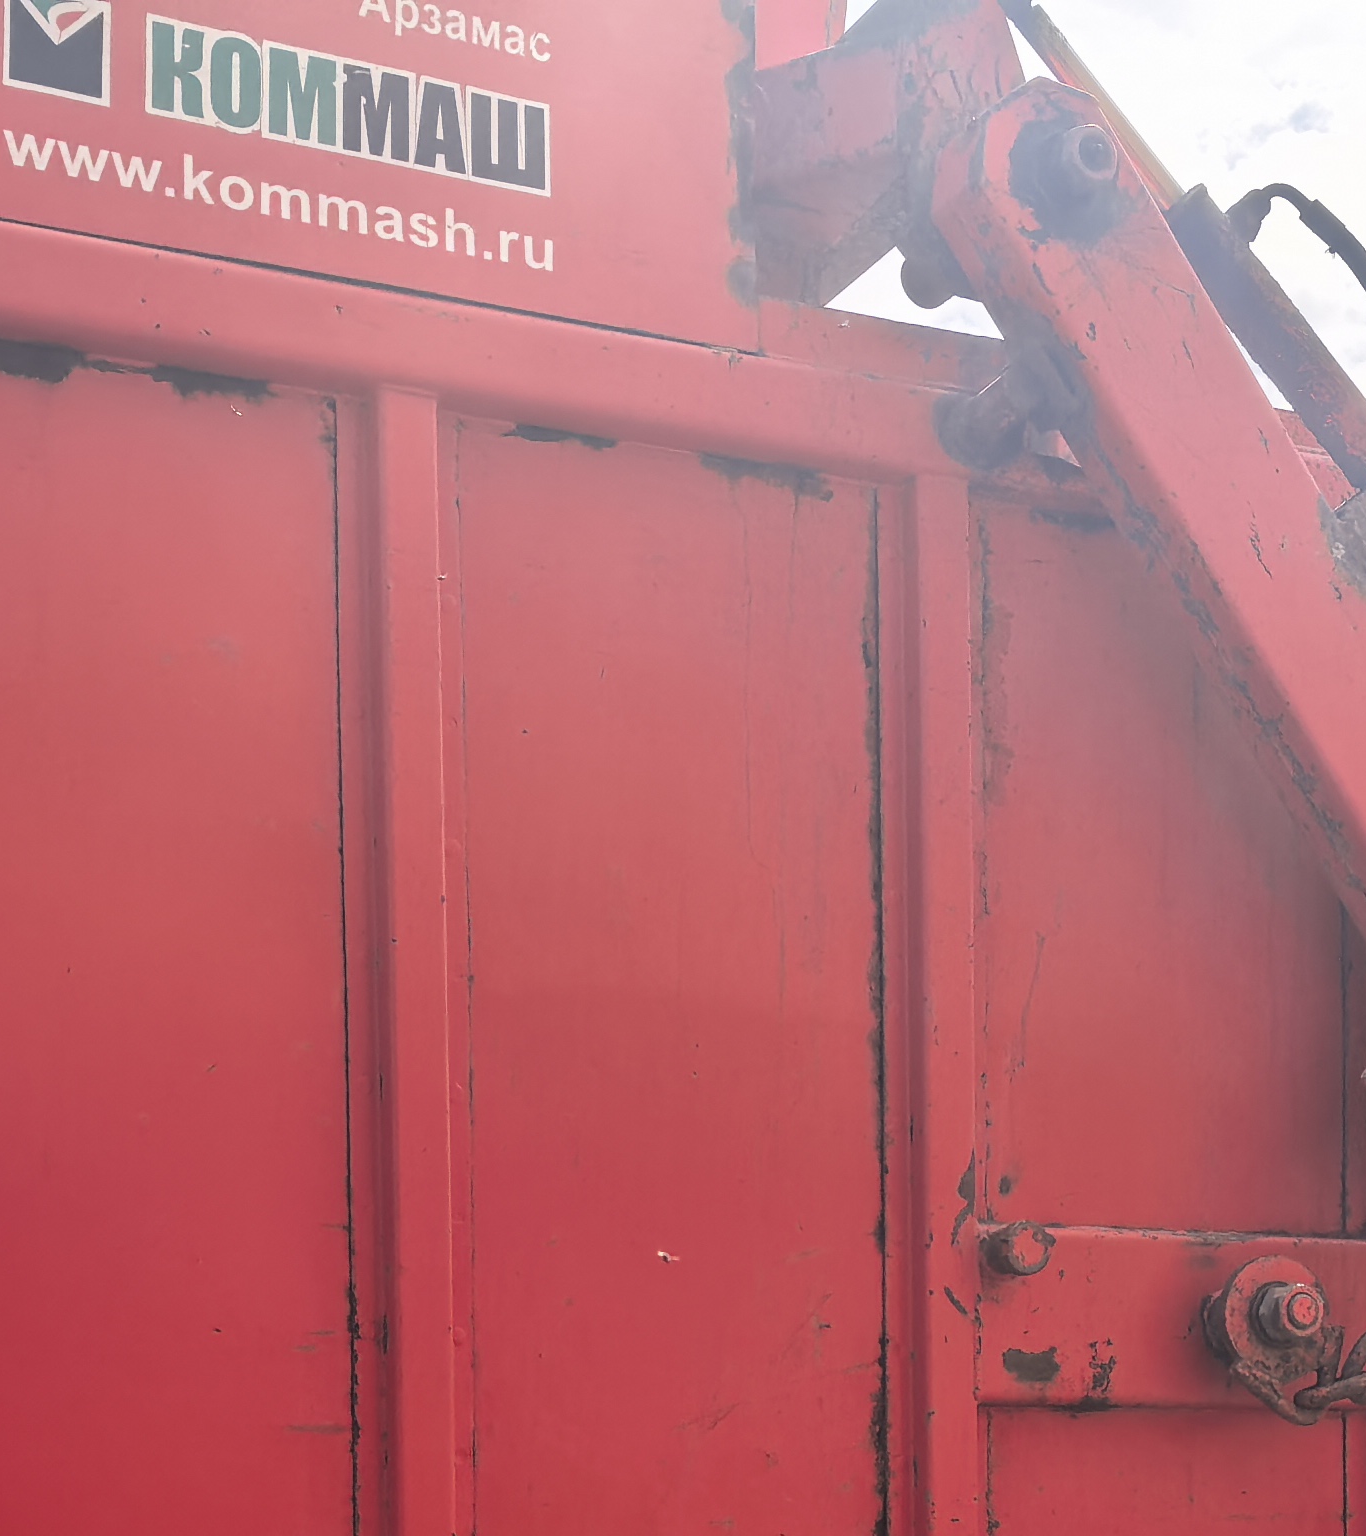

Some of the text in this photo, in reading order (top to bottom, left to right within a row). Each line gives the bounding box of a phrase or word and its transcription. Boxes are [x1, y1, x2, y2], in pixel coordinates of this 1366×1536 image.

[359, 0, 551, 62] Арзамас
[146, 14, 550, 197] КОММАШ
[3, 130, 554, 271] www.kommash.ru
